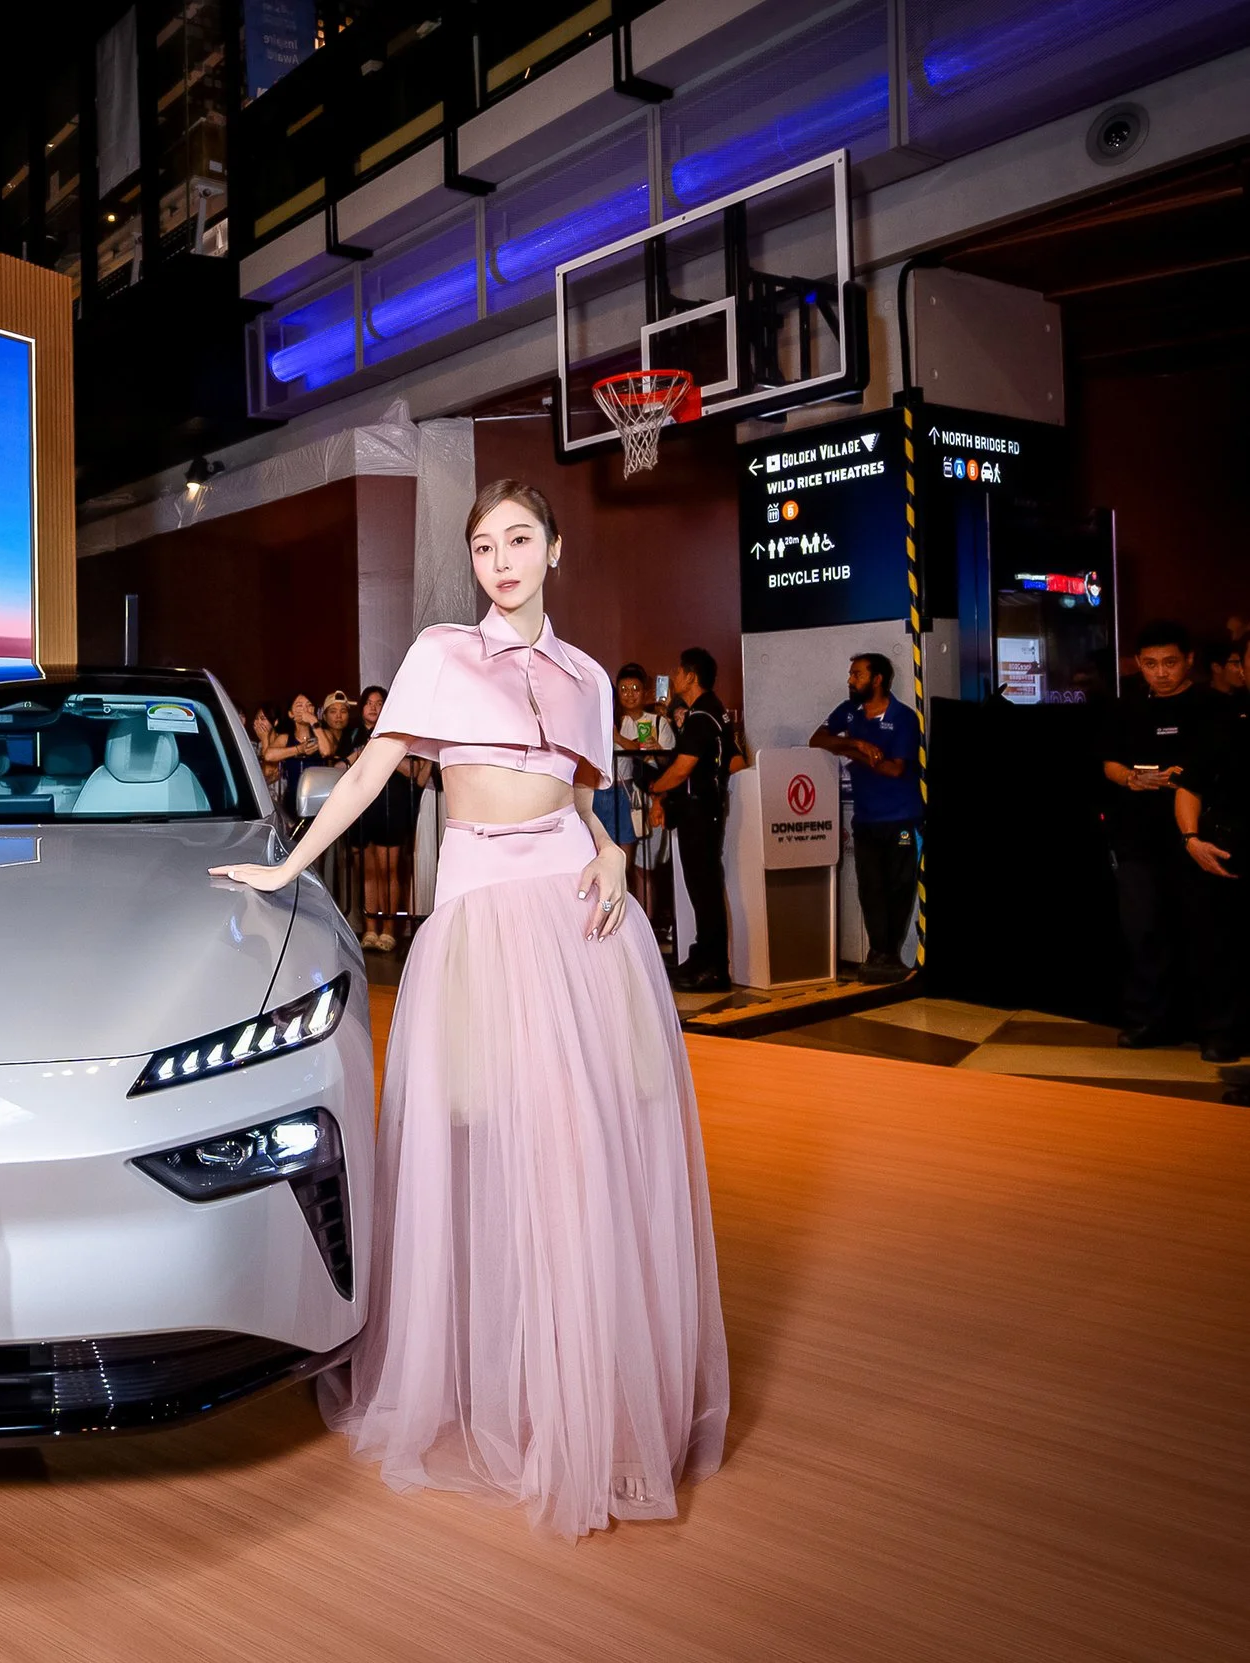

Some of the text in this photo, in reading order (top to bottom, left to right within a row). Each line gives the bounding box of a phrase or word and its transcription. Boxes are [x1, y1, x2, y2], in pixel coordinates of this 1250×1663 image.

[942, 430, 1020, 455] NORTH BRIDGE RD
[767, 461, 885, 495] WILD RICE THEATRES
[784, 536, 800, 546] 20m
[768, 565, 851, 588] BICYCLE HUB
[771, 821, 832, 833] DONGFENG
